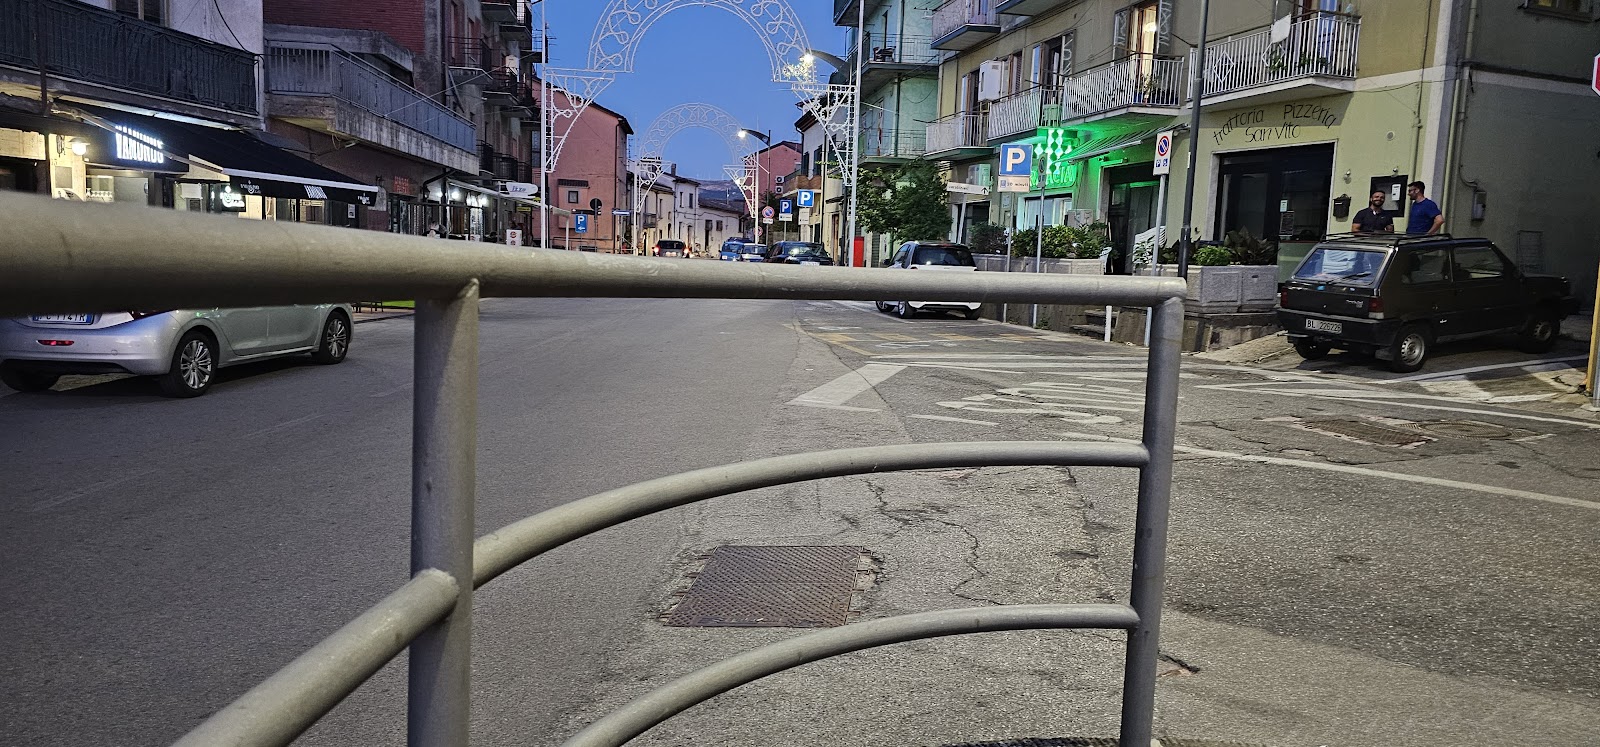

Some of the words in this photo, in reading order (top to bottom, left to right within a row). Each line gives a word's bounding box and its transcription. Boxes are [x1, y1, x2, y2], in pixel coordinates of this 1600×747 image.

[1213, 109, 1265, 146] trattoria
[1284, 102, 1337, 129] Pizzeria
[1245, 126, 1272, 143] San
[1275, 121, 1301, 140] Vito
[1006, 147, 1026, 172] P
[800, 192, 811, 204] P
[782, 202, 789, 212] P
[577, 216, 584, 224] P
